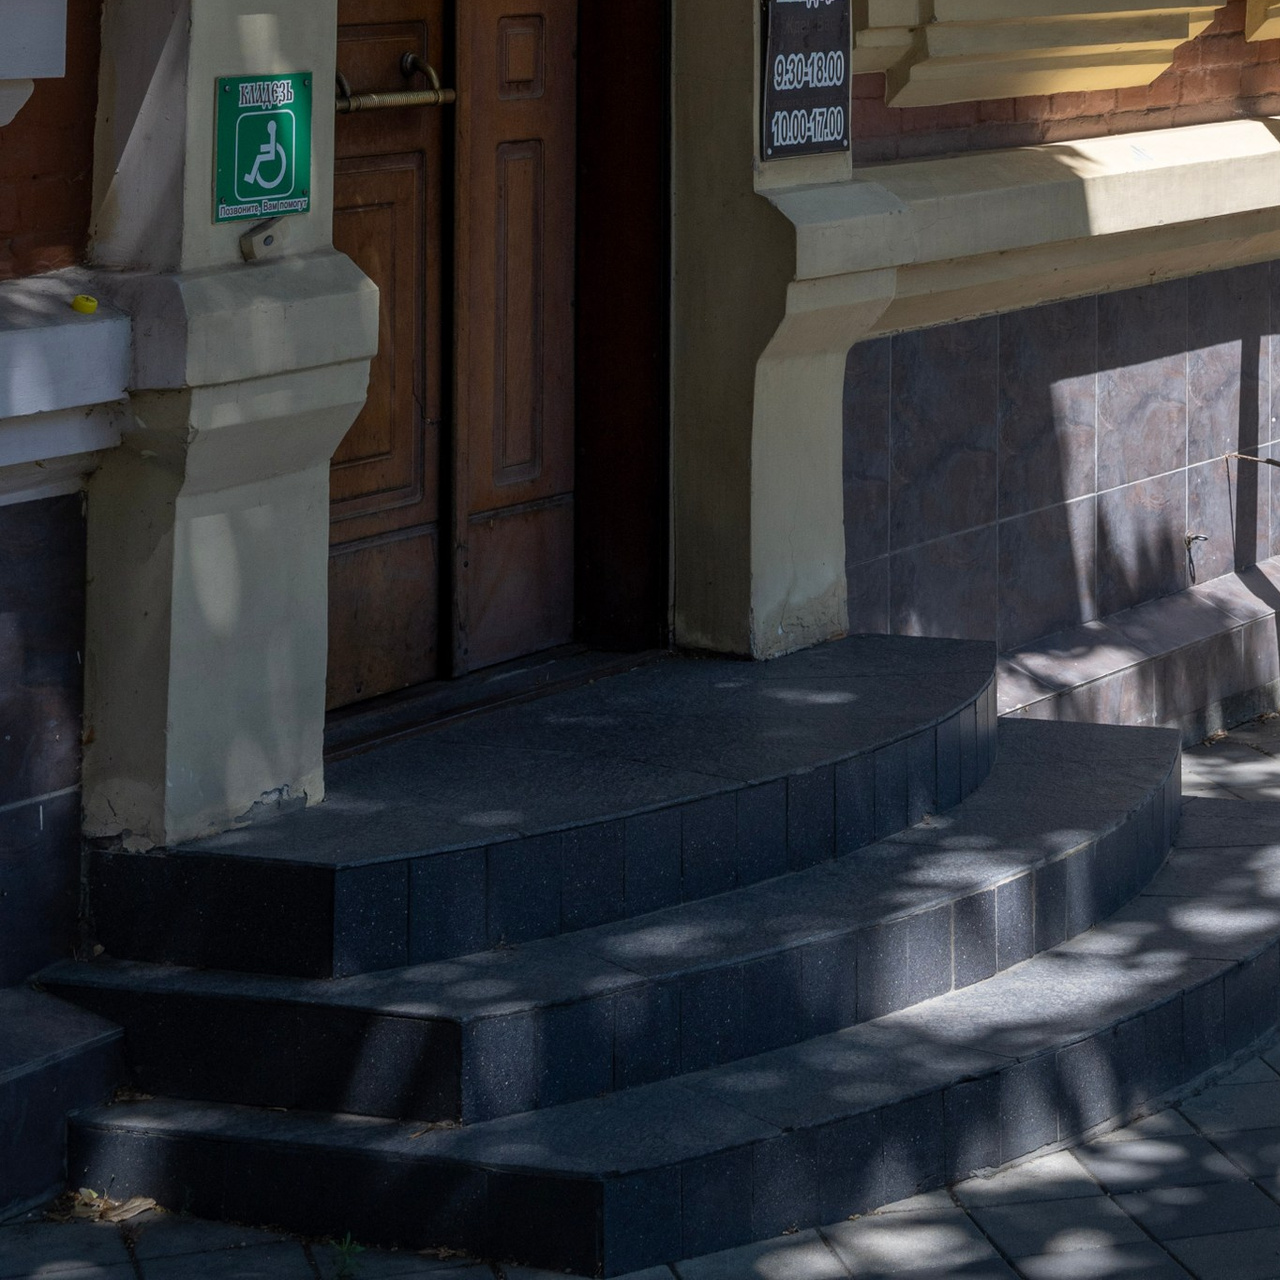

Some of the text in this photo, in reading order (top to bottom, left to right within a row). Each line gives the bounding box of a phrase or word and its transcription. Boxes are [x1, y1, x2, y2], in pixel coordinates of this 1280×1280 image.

[774, 51, 845, 91] 9.30-18.00
[772, 106, 844, 146] 10.00-17.00
[219, 198, 308, 218] Позвоните, Вам помогут
